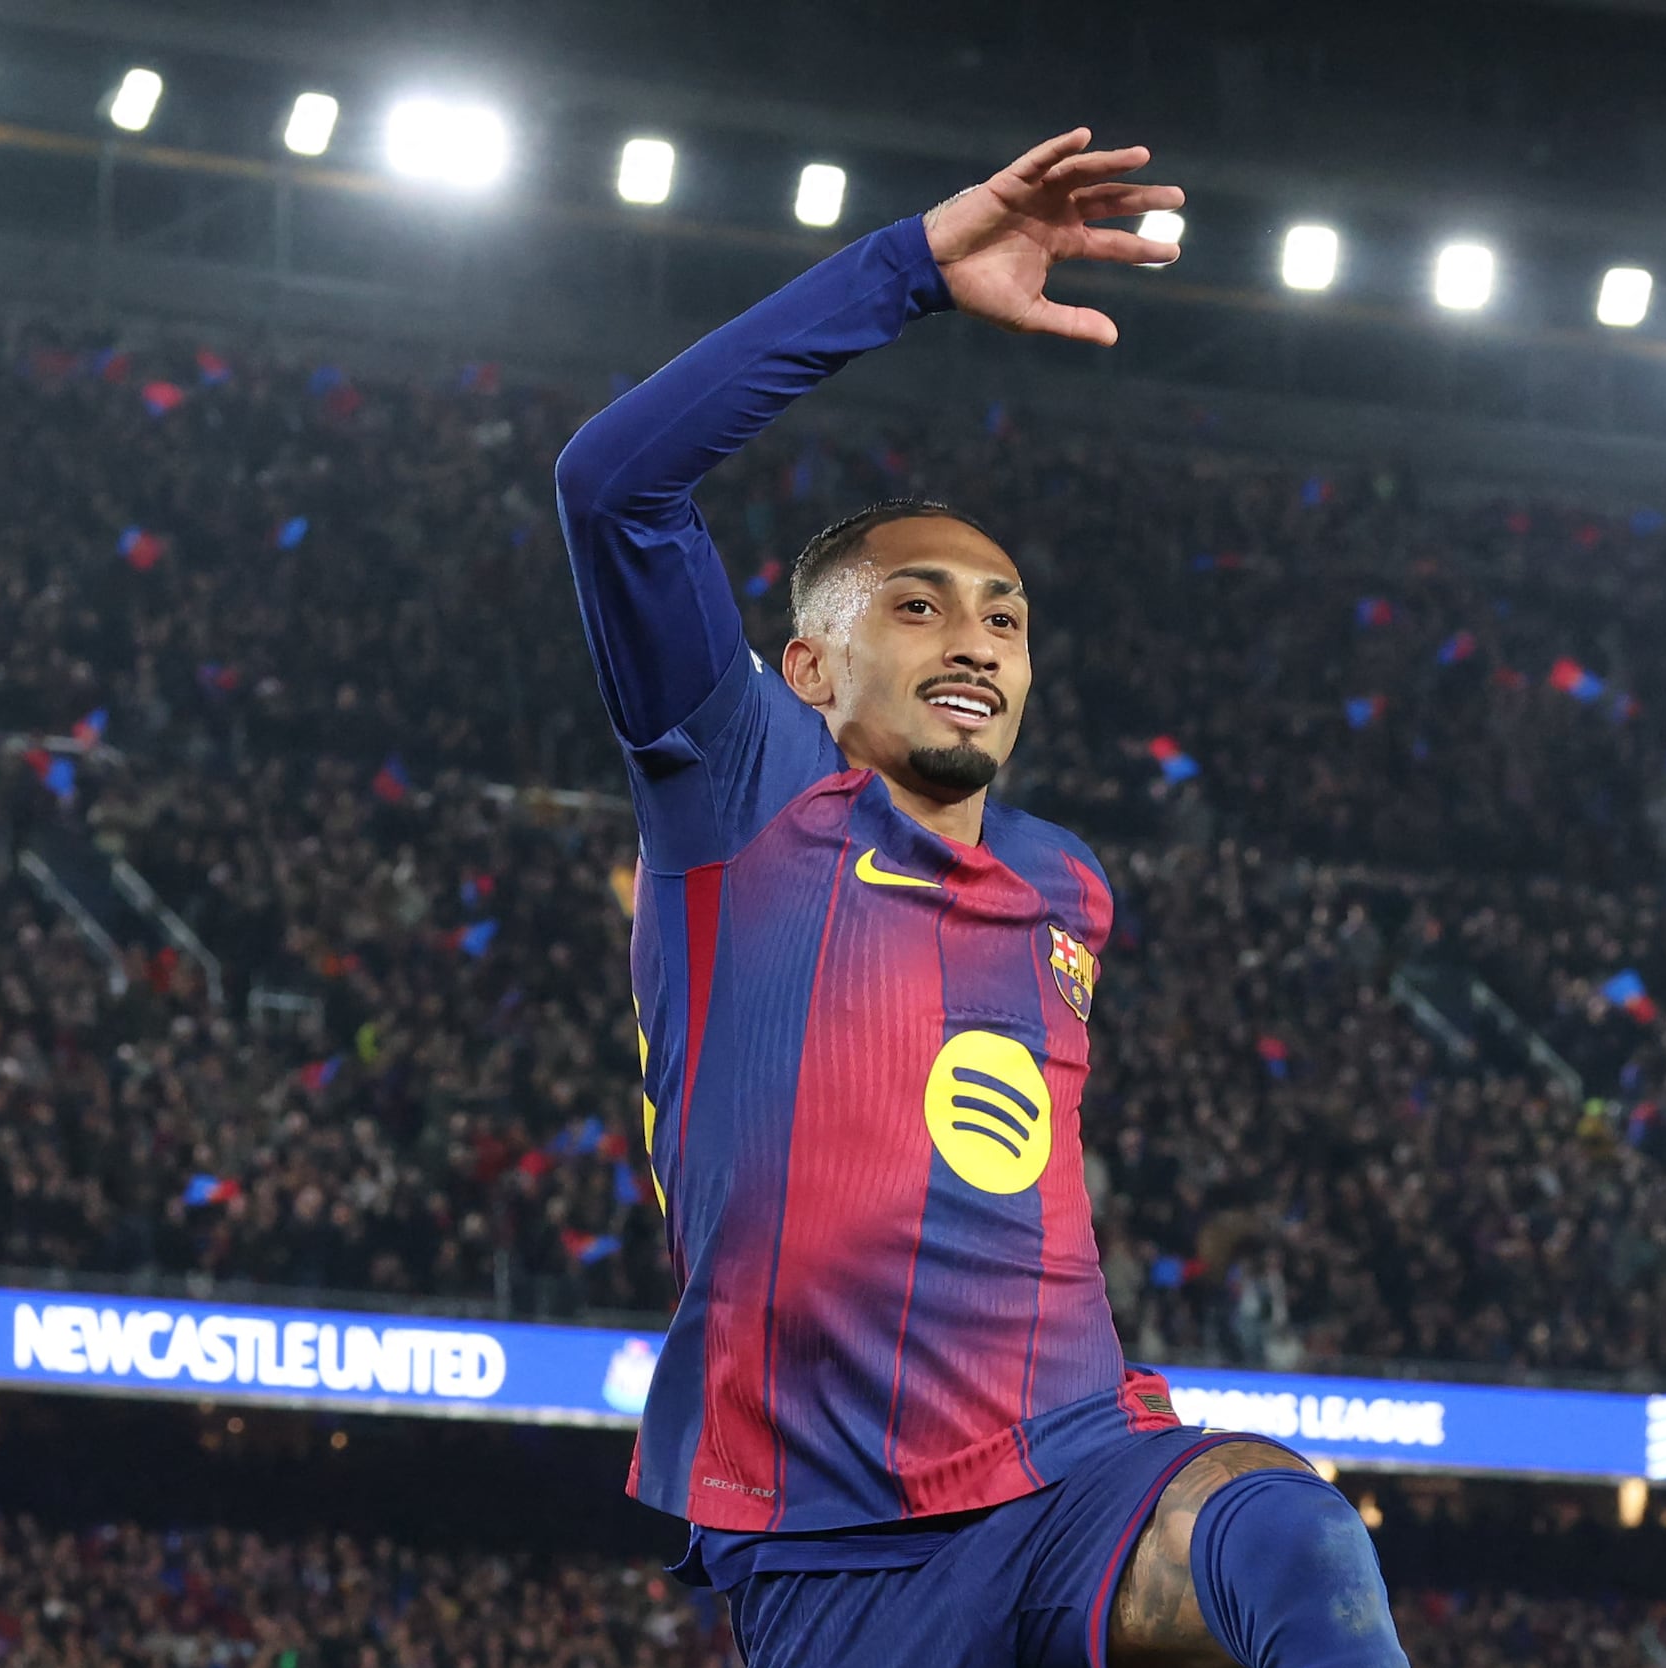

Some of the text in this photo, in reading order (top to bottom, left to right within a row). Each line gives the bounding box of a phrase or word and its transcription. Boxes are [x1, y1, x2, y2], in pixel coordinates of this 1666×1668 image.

[14, 1304, 506, 1397] NEWCASTLE UNITED
[1299, 1395, 1444, 1446] LEAGUE
